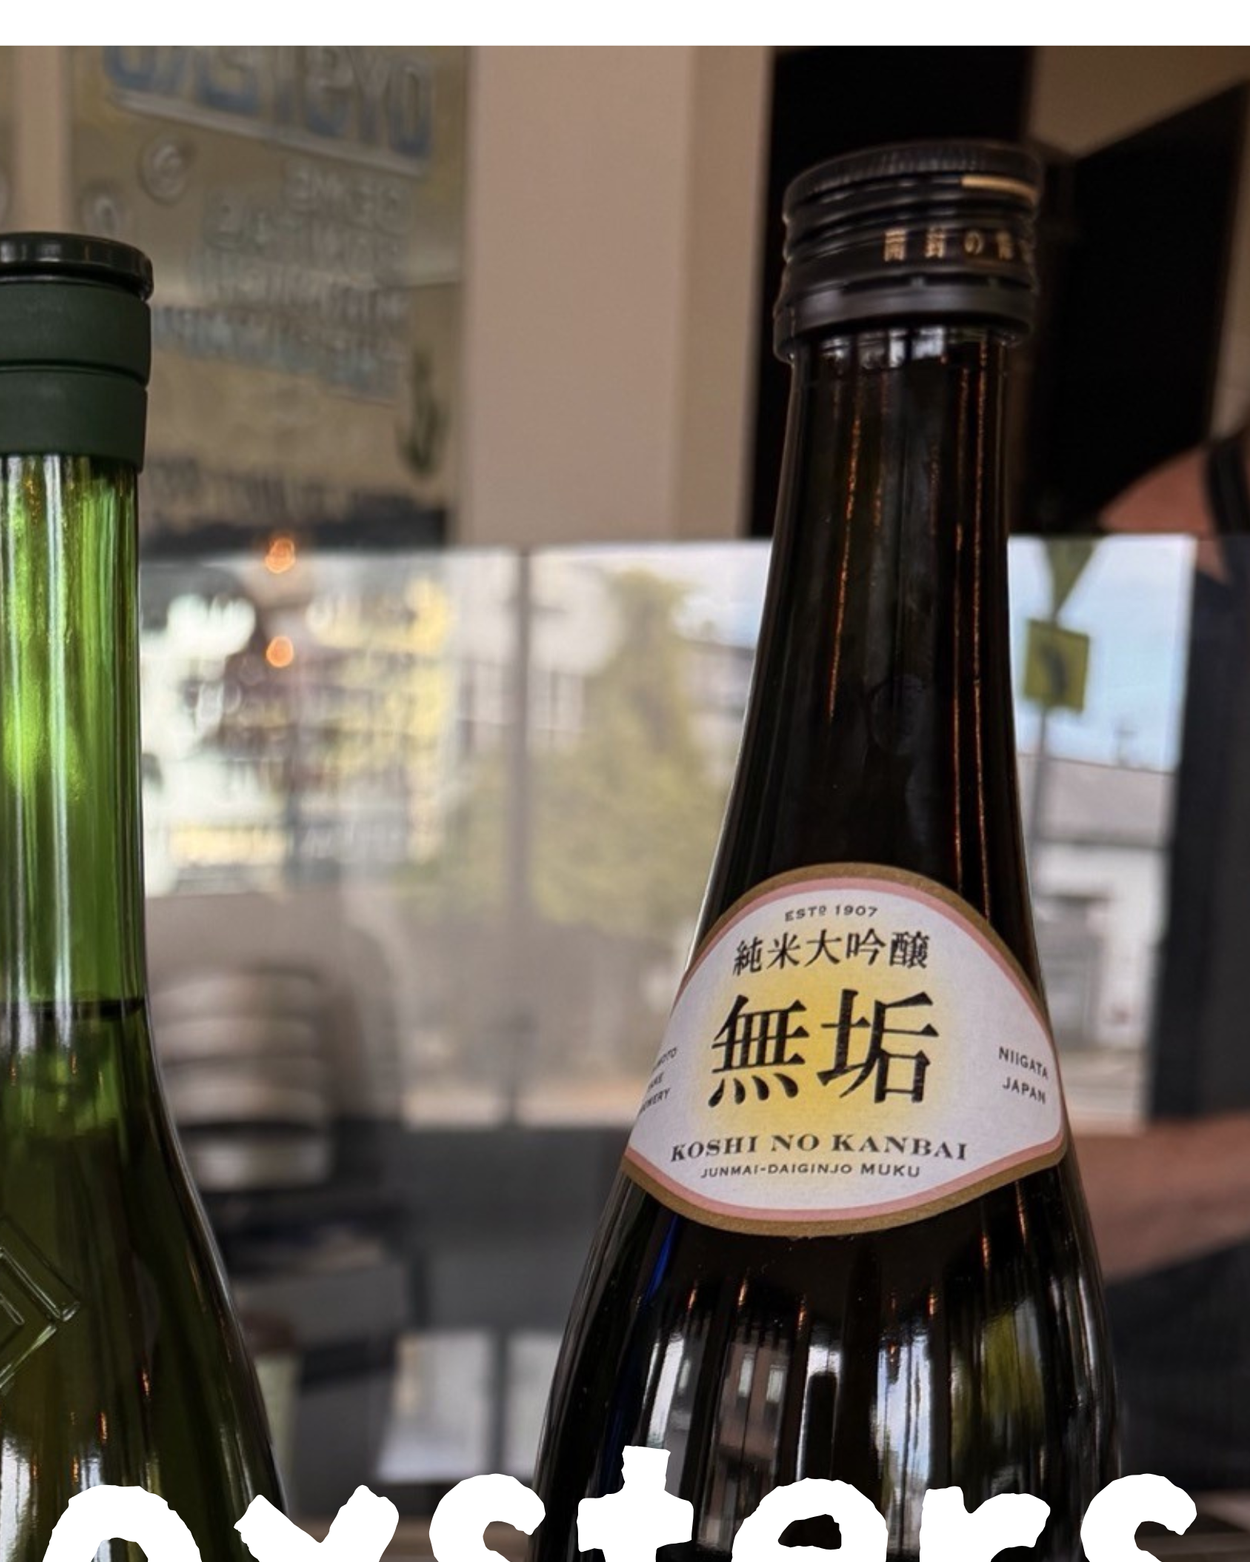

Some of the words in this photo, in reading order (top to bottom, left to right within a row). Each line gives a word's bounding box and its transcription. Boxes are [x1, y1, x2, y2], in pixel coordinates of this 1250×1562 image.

[835, 904, 878, 917] 1907
[733, 928, 931, 976] 純米大吟醸
[707, 988, 940, 1109] 無垢
[999, 1046, 1048, 1080] NIIGATA
[1002, 1077, 1046, 1105] JAPAN
[670, 1135, 758, 1163] KOSHI
[771, 1134, 820, 1151] NO
[832, 1134, 967, 1161] KANBAI
[701, 1163, 852, 1178] JUNMAI-DAIGINJO
[861, 1163, 921, 1178] MUKU
